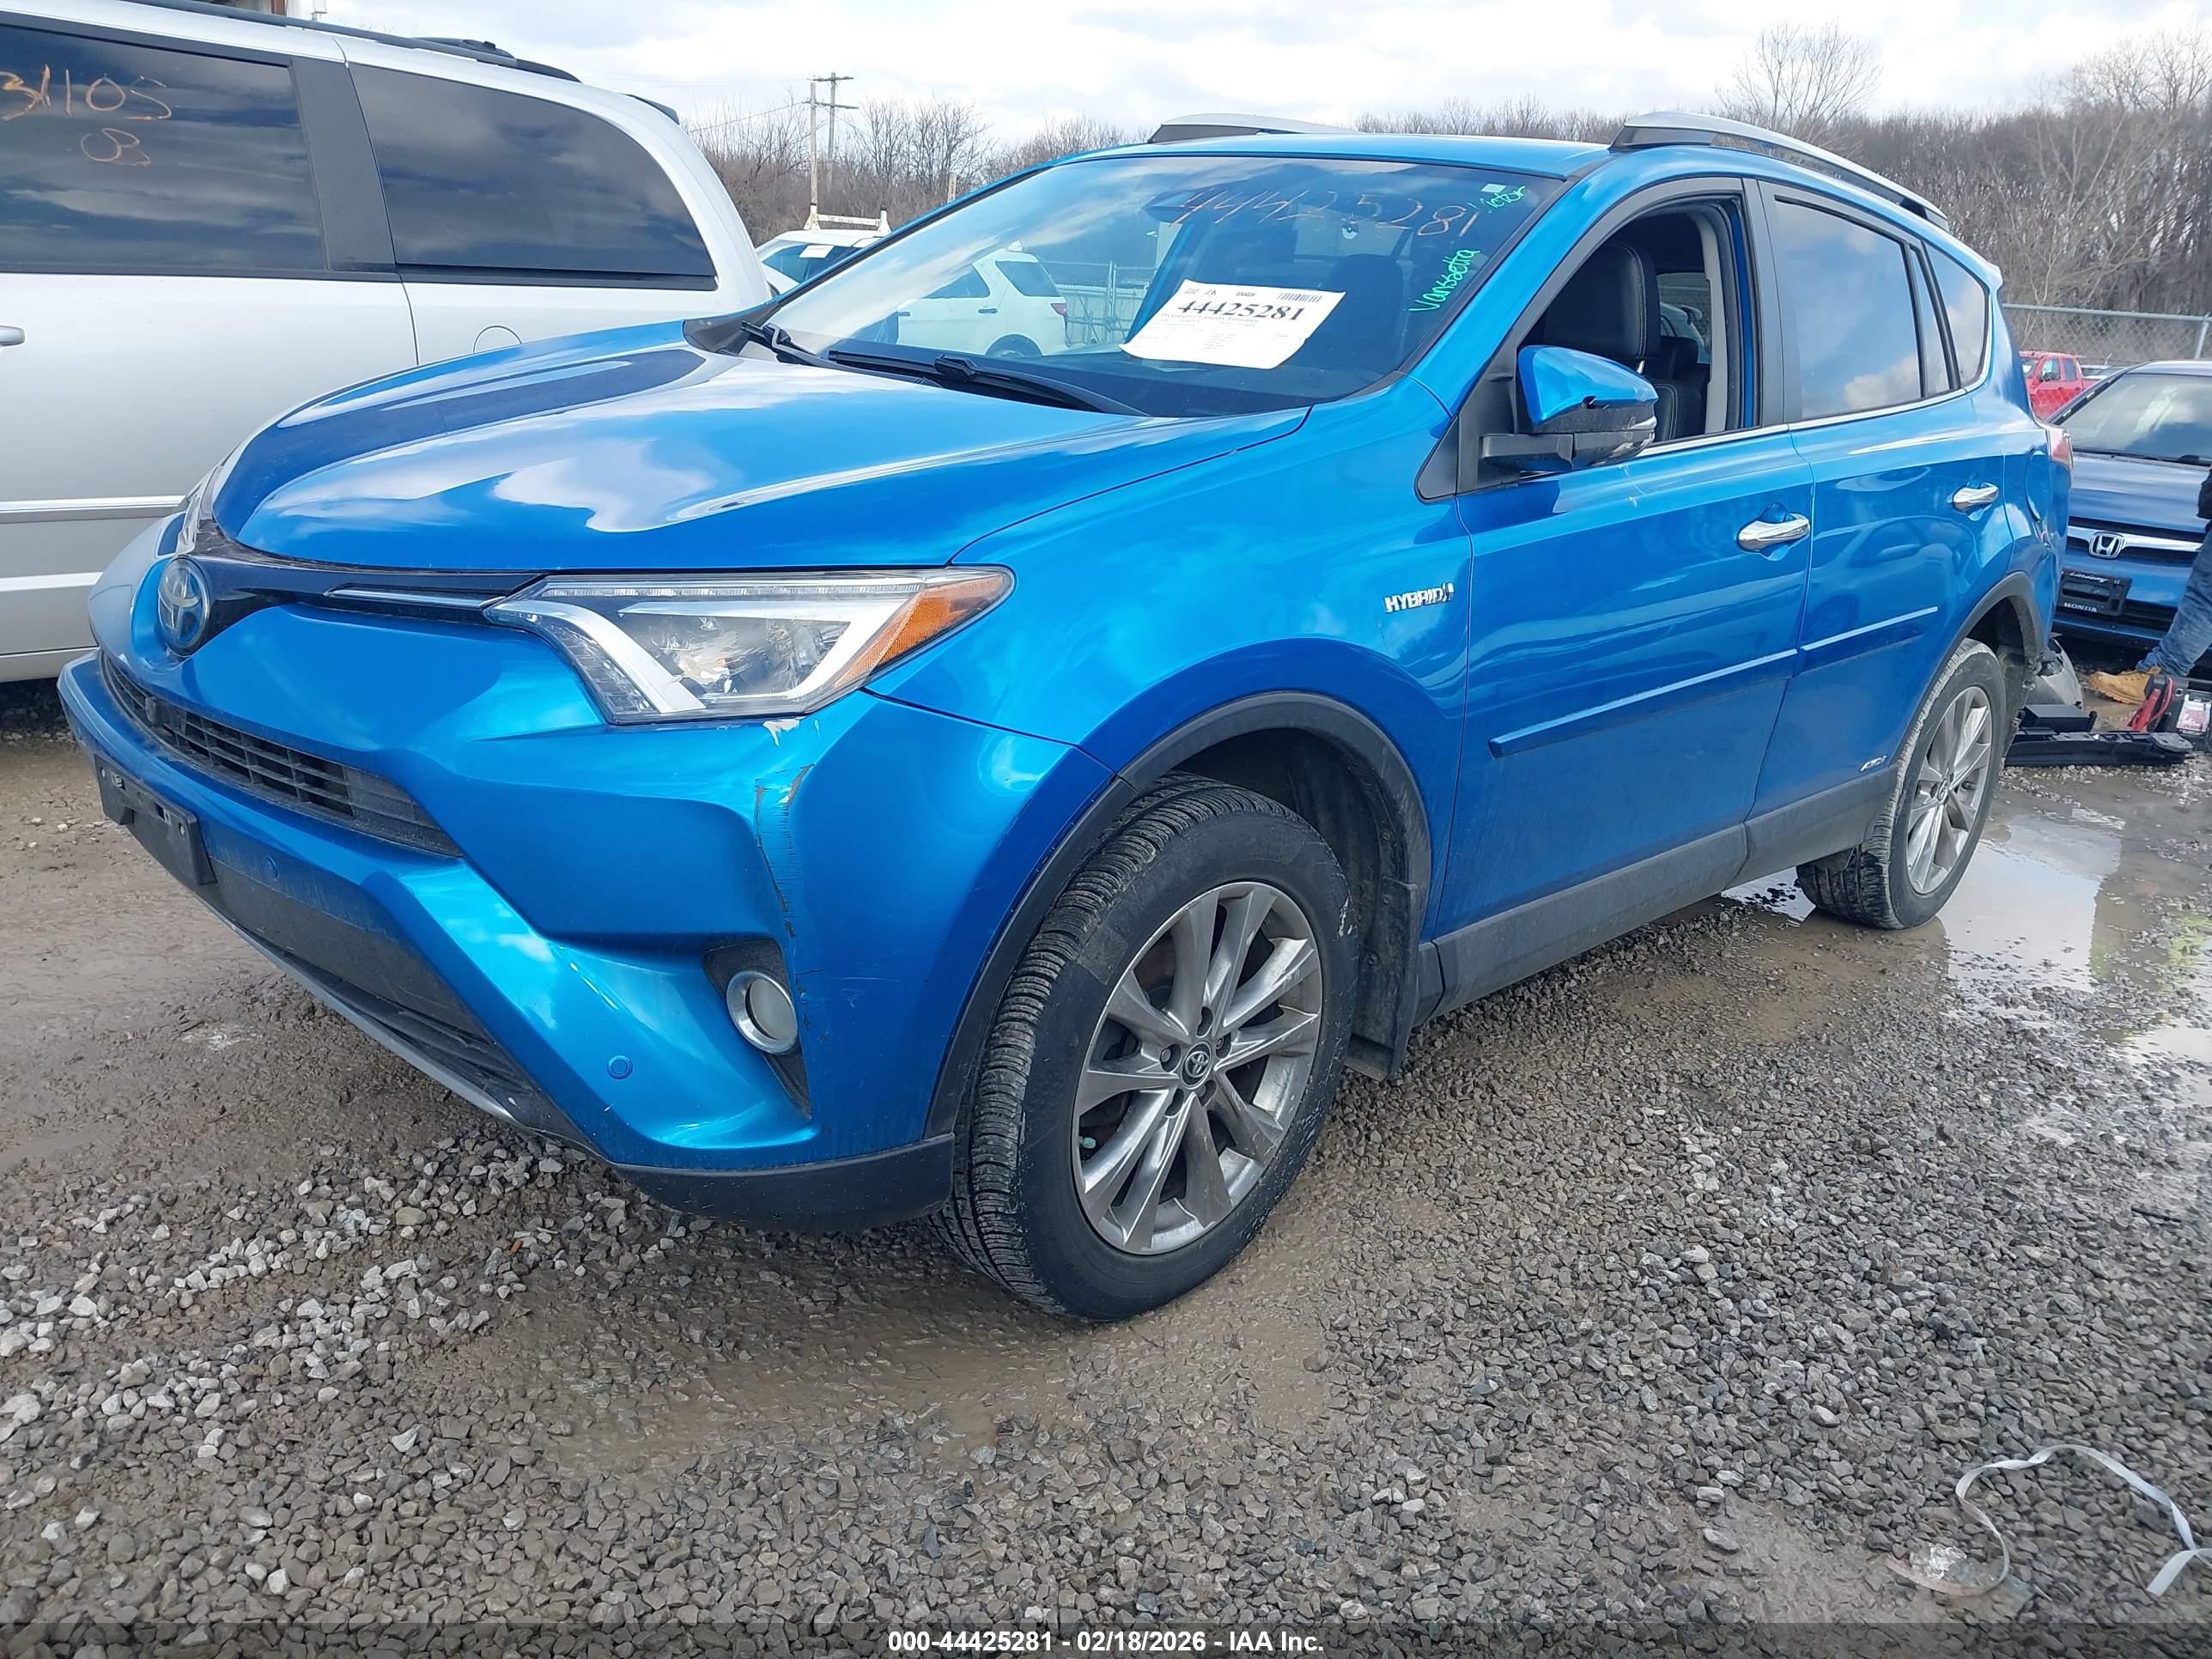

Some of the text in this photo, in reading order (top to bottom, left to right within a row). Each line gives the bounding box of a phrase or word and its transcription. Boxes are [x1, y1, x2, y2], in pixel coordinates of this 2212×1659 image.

[1170, 188, 1480, 236] 44425281
[1177, 300, 1305, 321] 44425281
[1384, 587, 1443, 612] HYBRID
[2063, 603, 2097, 612] HONDA
